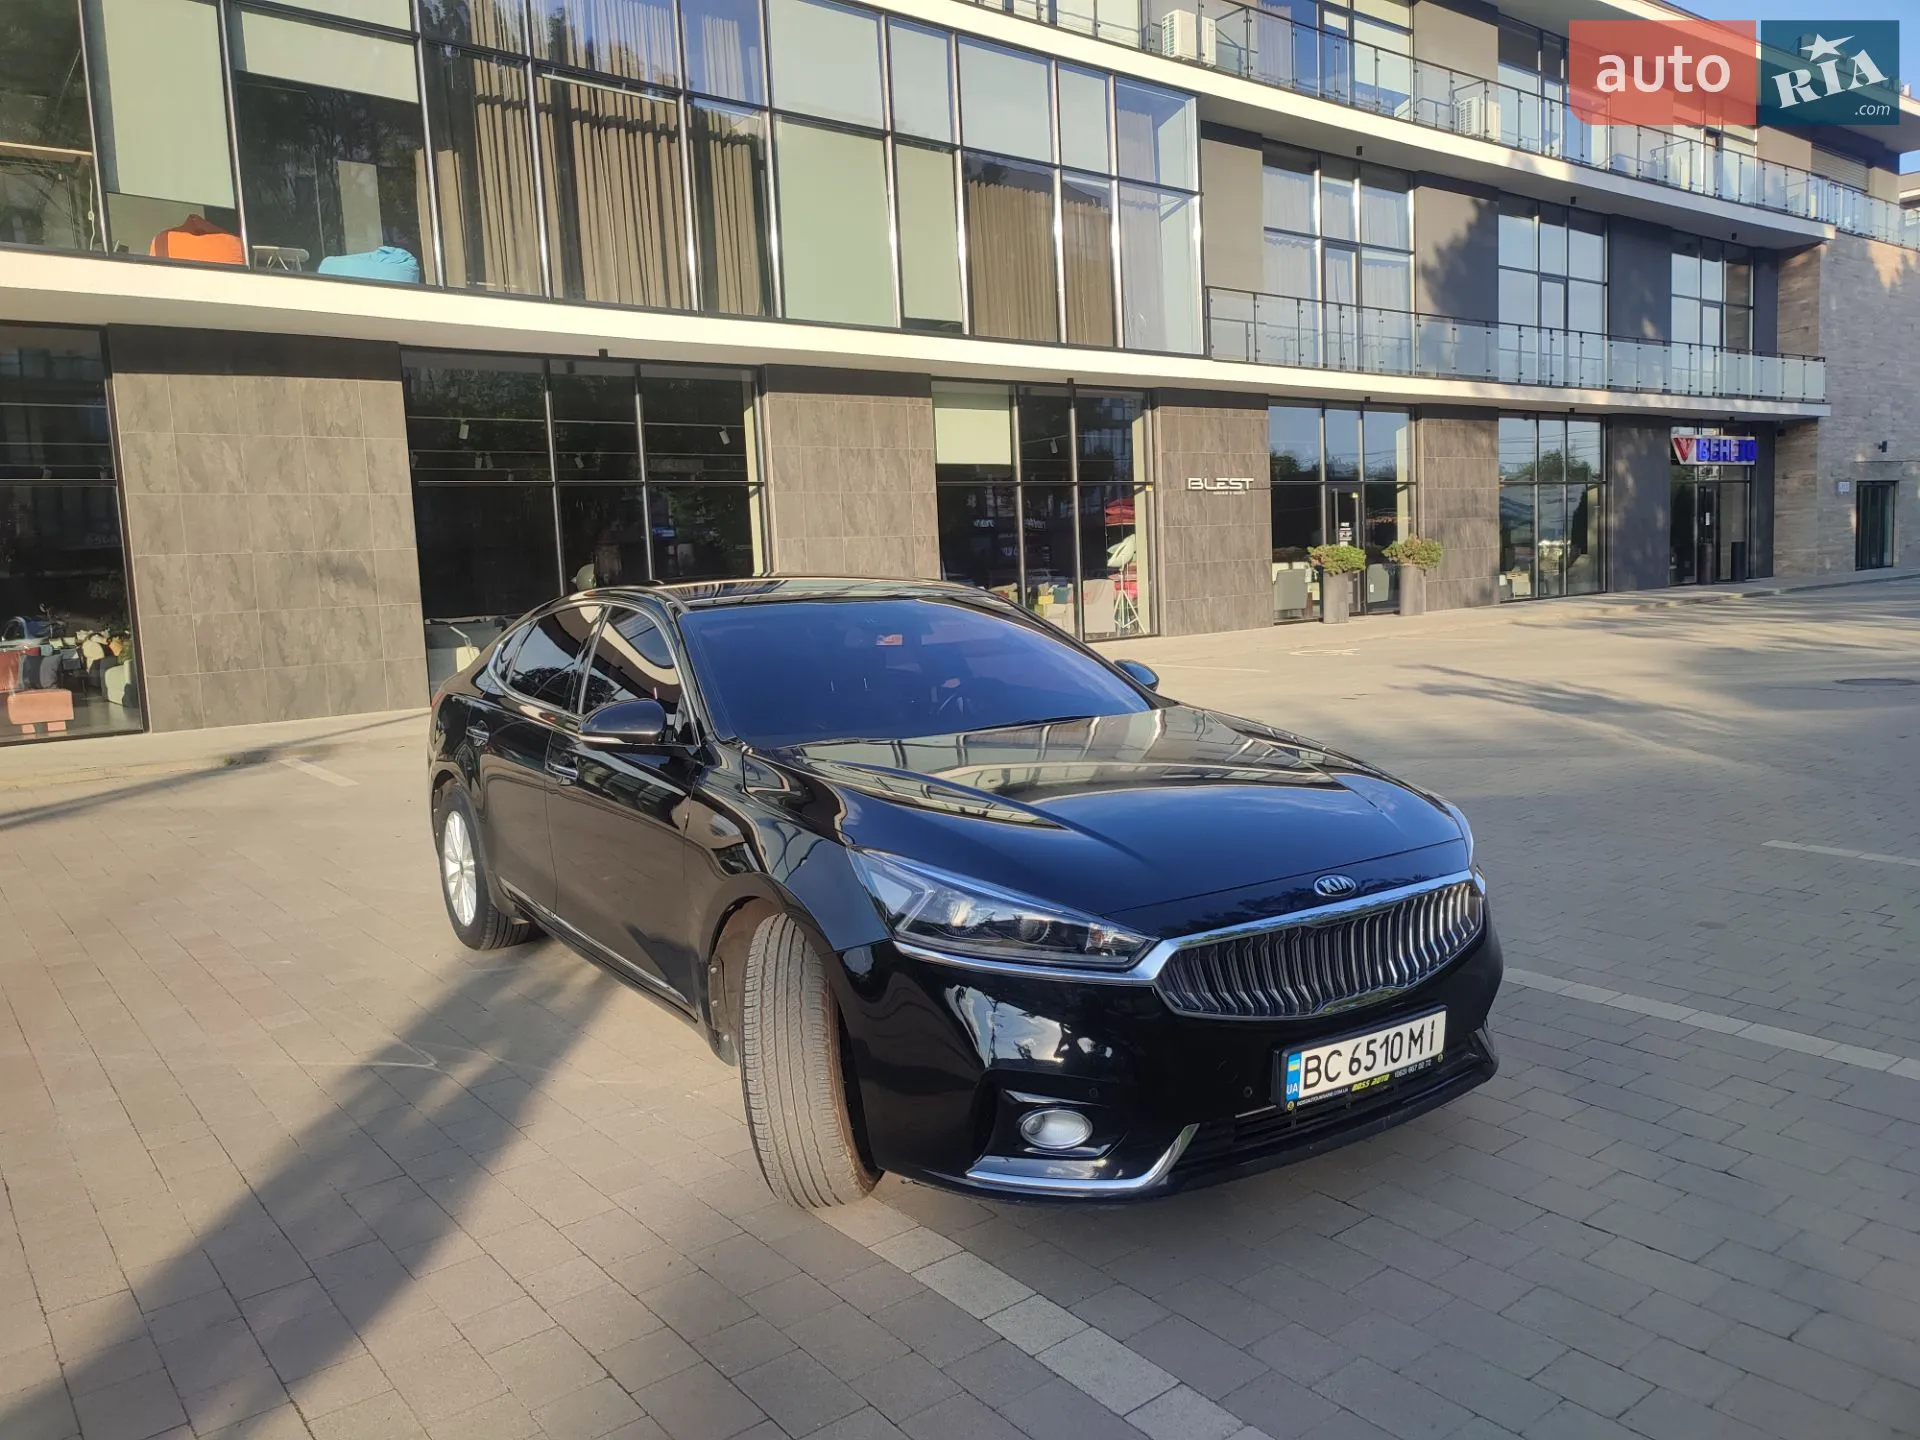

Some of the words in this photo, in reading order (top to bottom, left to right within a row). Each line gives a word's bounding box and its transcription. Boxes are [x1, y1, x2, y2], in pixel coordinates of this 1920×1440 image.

[1187, 477, 1255, 490] BLEST
[1319, 877, 1353, 893] KIA
[1348, 1031, 1403, 1076] 6510
[1286, 1083, 1299, 1095] UA
